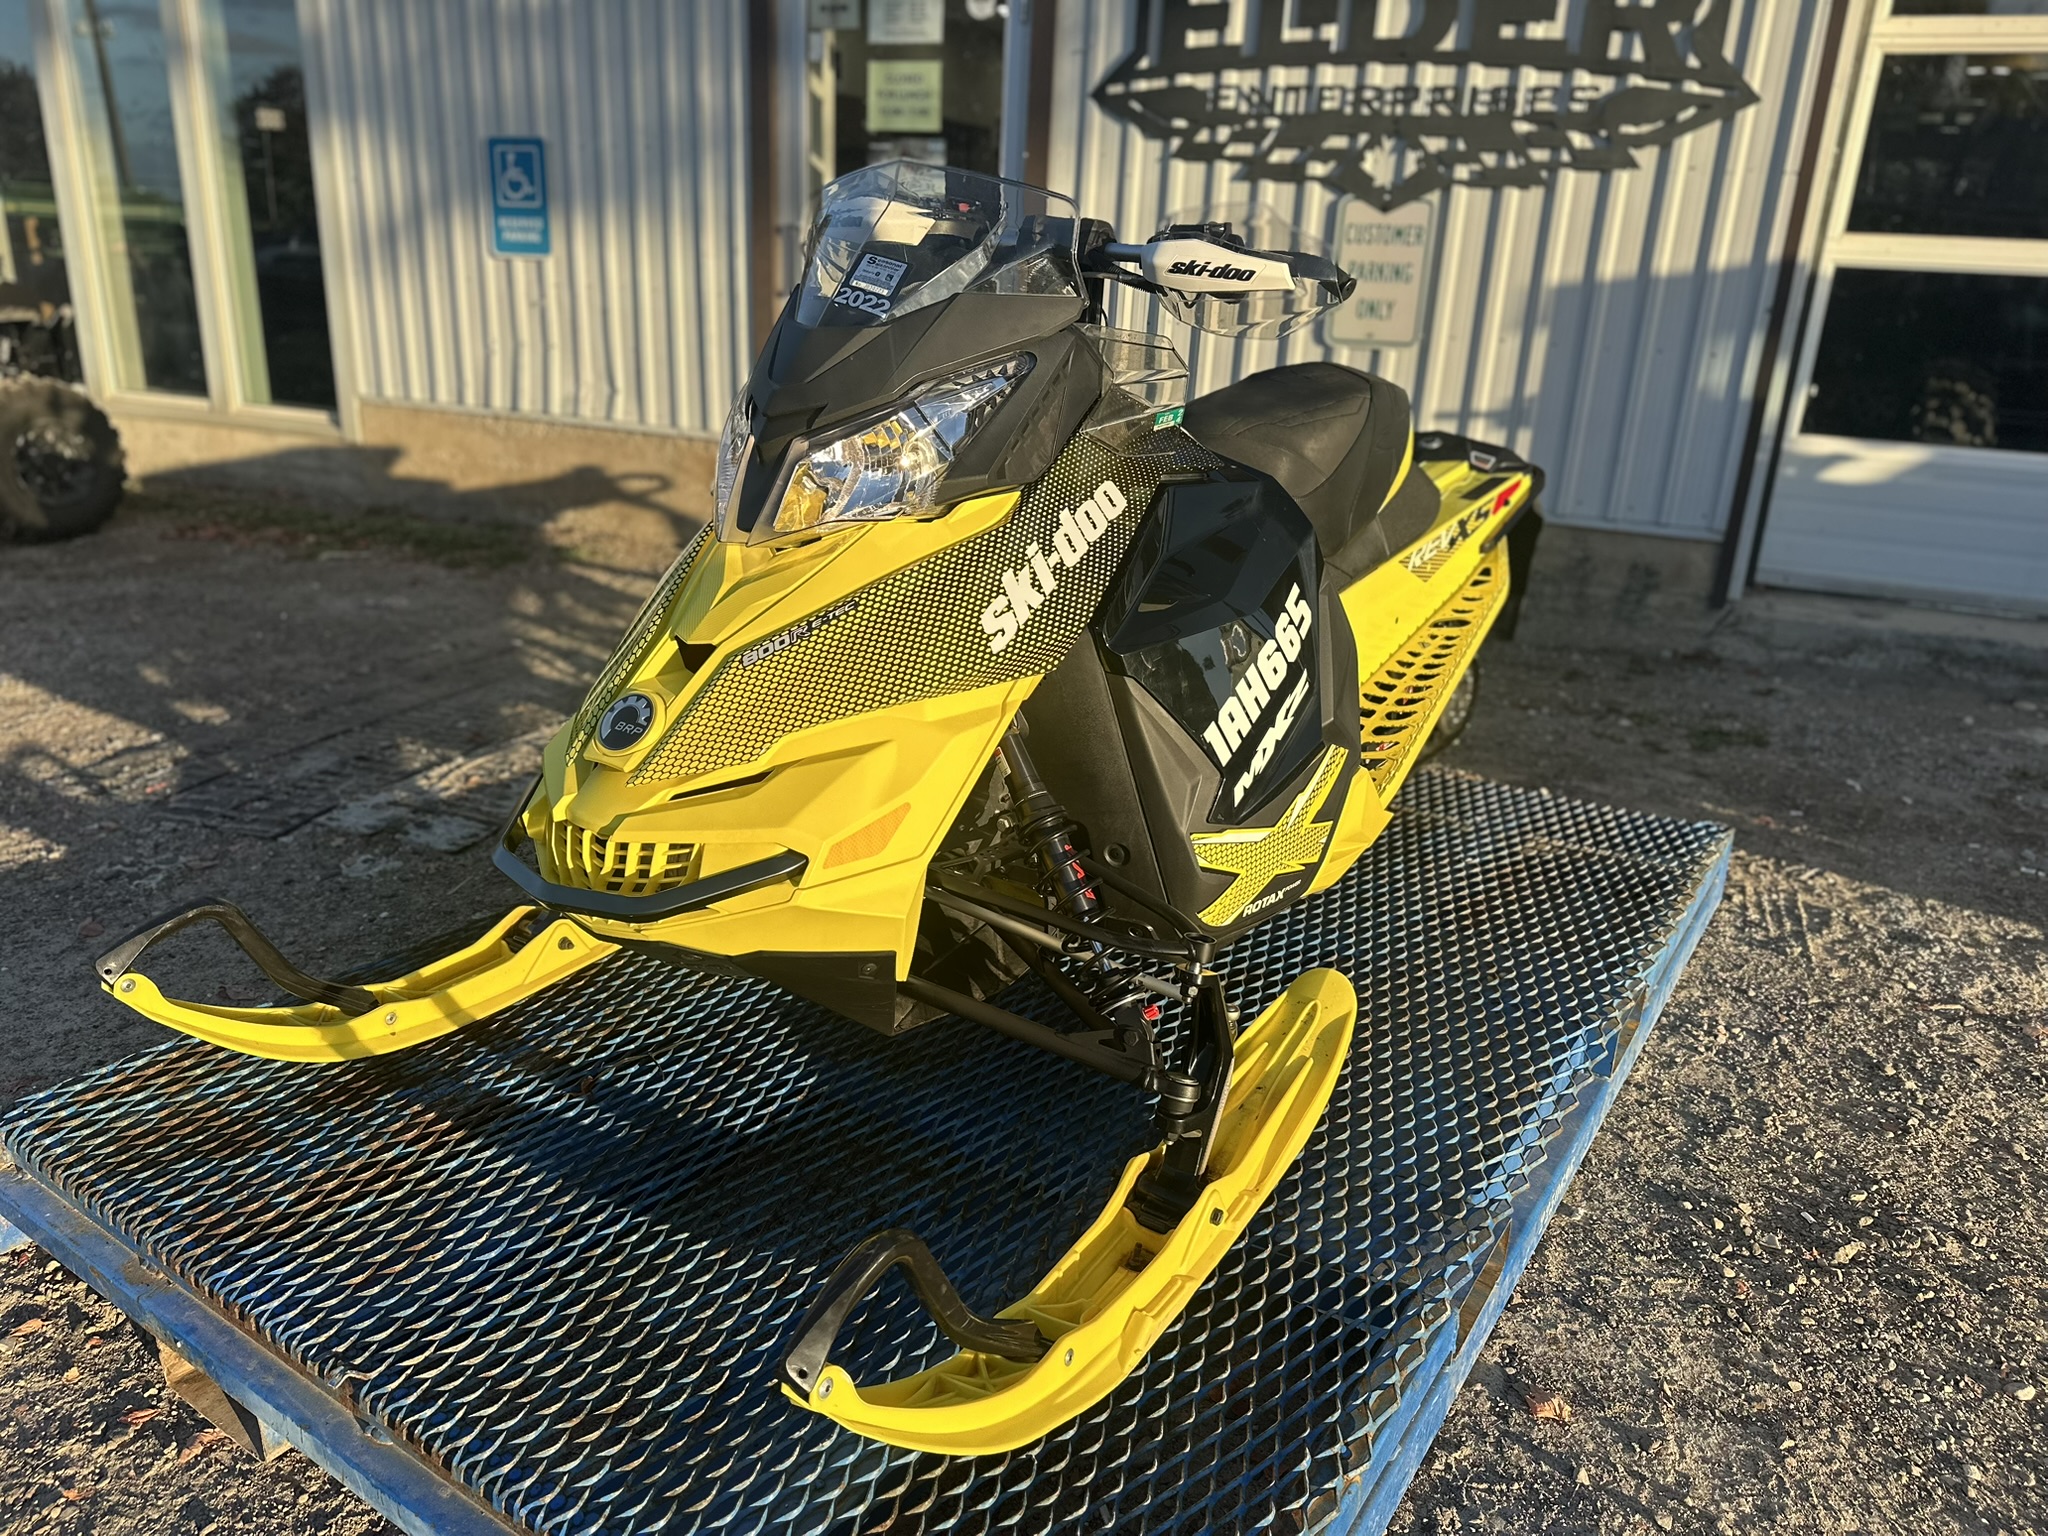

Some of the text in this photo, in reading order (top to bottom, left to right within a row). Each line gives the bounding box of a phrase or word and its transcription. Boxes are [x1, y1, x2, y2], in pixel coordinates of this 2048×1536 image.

[1346, 222, 1424, 247] CUSTOMER
[1167, 260, 1256, 281] ski-doo
[1348, 260, 1414, 285] PARKING
[834, 287, 891, 319] 2022
[1355, 299, 1397, 321] ONLY
[1158, 413, 1175, 424] FEB
[980, 480, 1128, 654] ski-doo
[742, 600, 856, 667] 800R E-TEC
[1203, 582, 1312, 767] 1AH665
[615, 721, 643, 735] BRP
[1242, 888, 1286, 917] ROTAX
